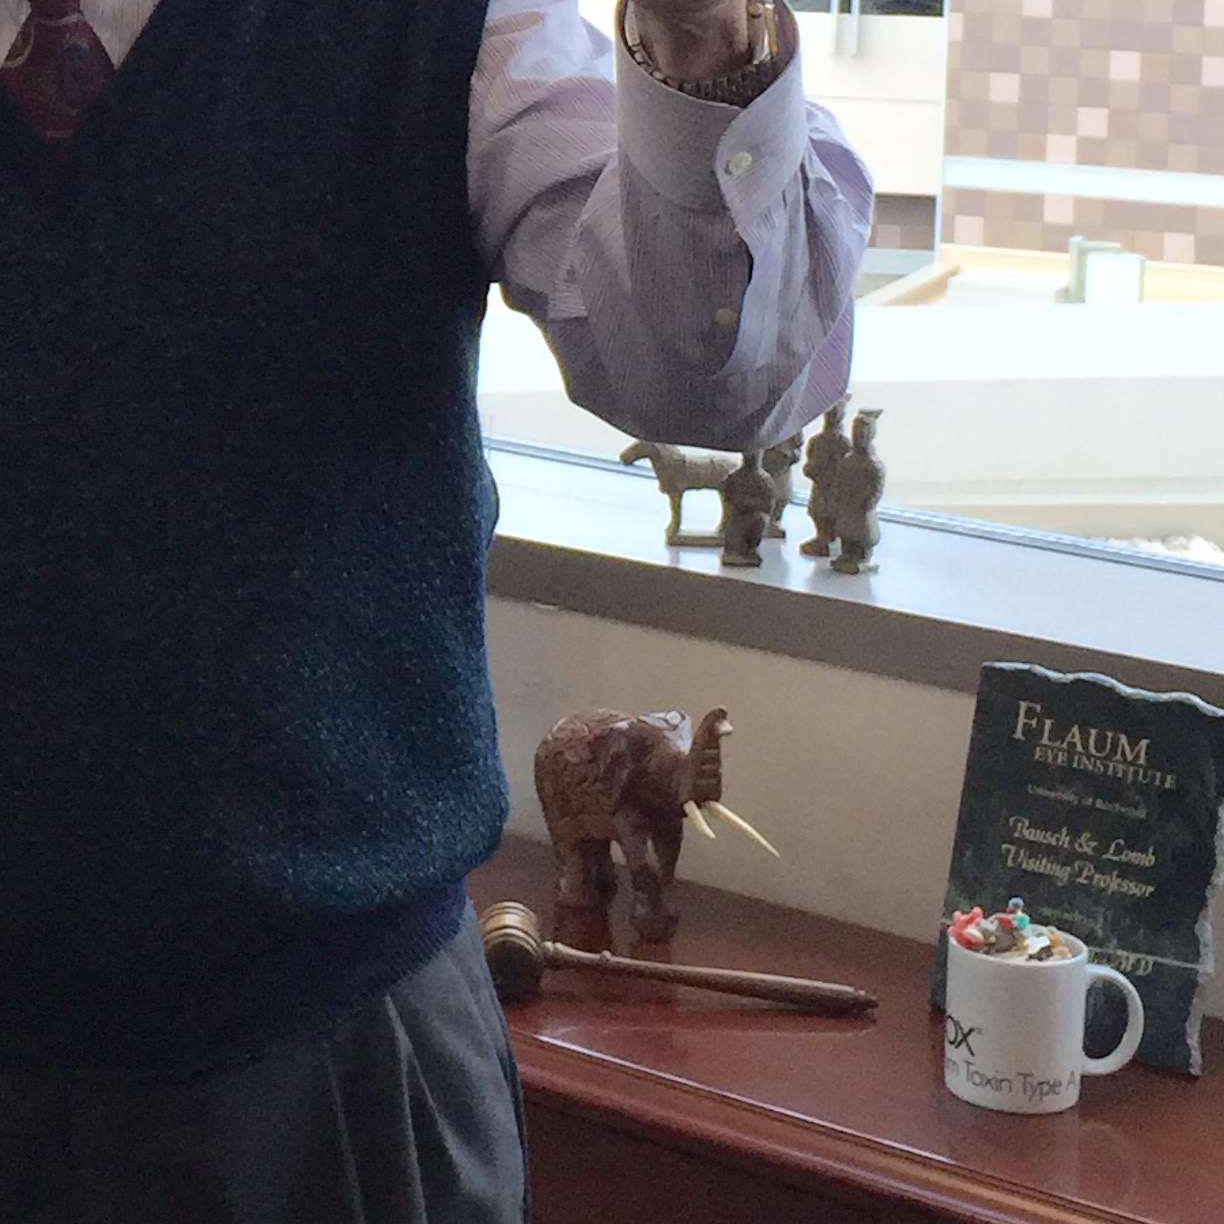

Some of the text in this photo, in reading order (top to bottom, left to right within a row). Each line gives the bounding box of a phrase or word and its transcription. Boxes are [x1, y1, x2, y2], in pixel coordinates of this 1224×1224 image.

[1012, 699, 1151, 766] FLAUM
[1033, 745, 1177, 790] EYE INSTITUTE
[1008, 815, 1156, 868] Bausch & Lomb
[1000, 843, 1156, 898] Visiting Professor
[962, 1059, 1013, 1094] Toxin
[1016, 1072, 1063, 1101] Type
[1066, 1070, 1078, 1090] A
